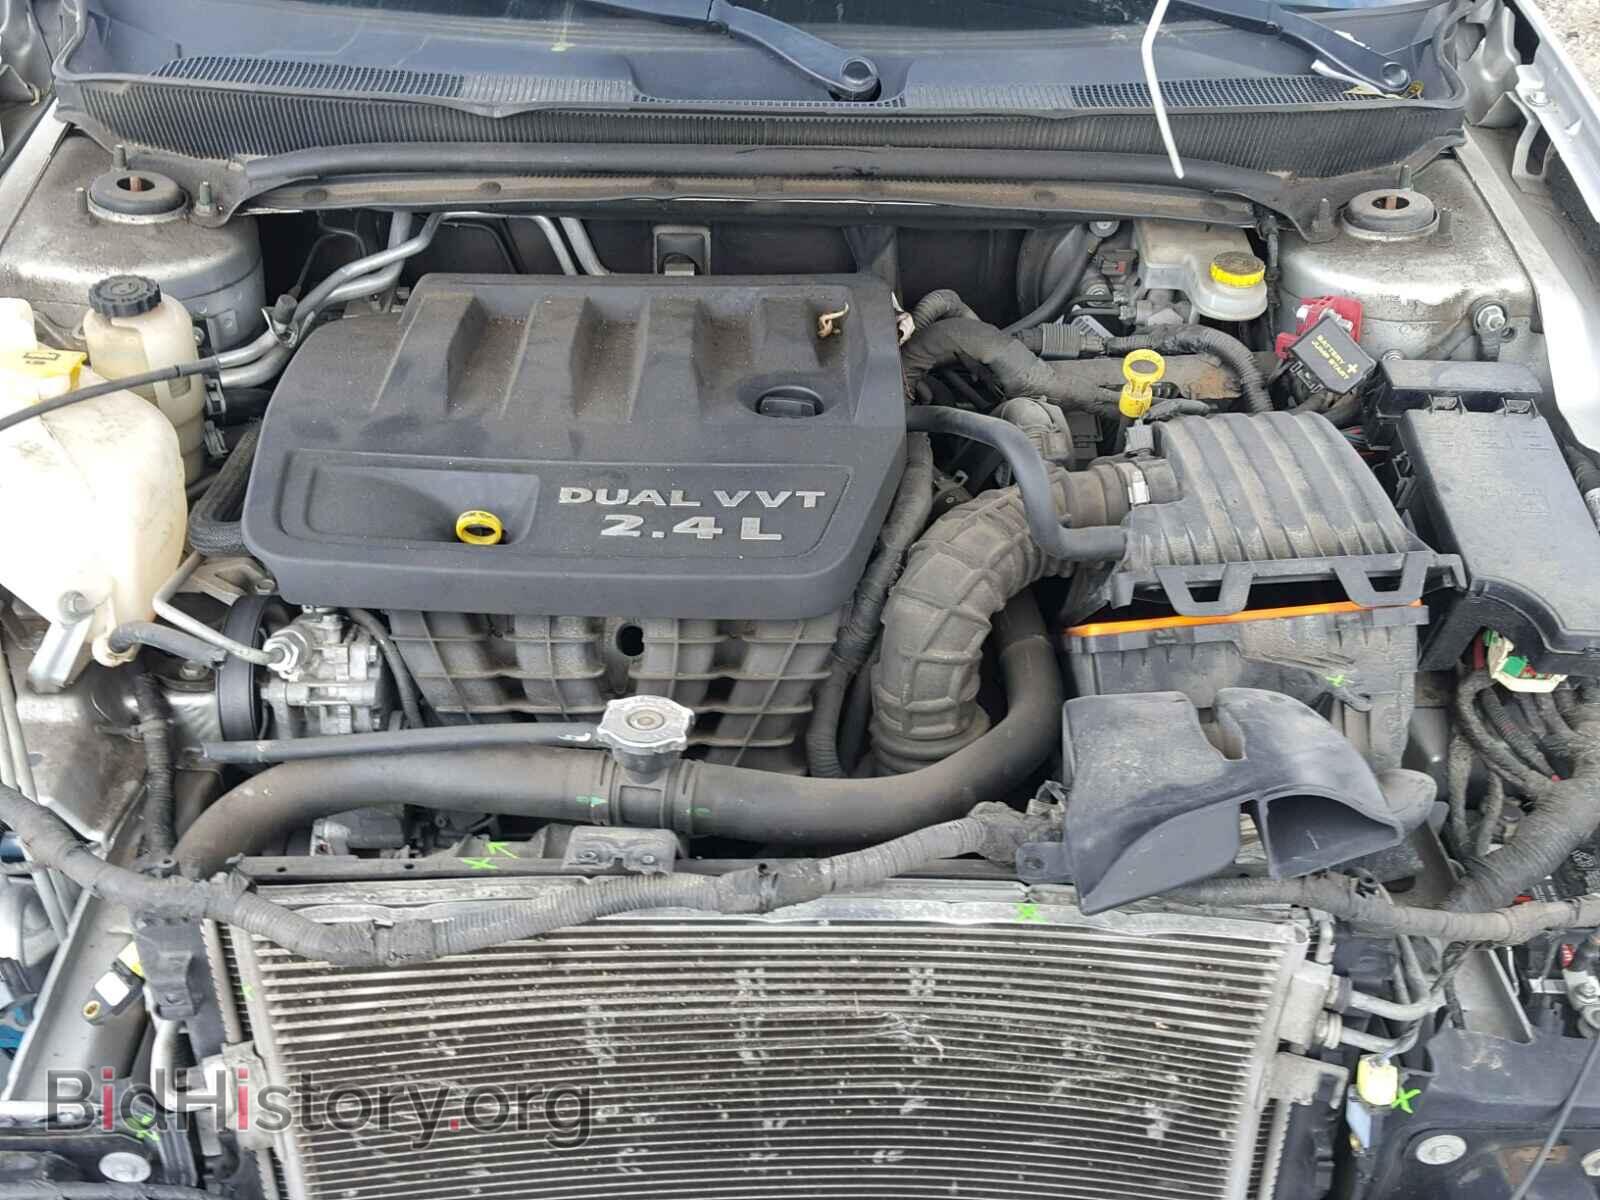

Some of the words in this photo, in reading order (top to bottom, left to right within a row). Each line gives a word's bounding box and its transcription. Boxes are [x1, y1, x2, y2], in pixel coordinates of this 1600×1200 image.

[1312, 340, 1330, 358] JUMP
[1328, 358, 1350, 379] START
[1316, 335, 1344, 364] BATTERY
[559, 487, 701, 506] DUAL
[713, 490, 826, 508] VVT
